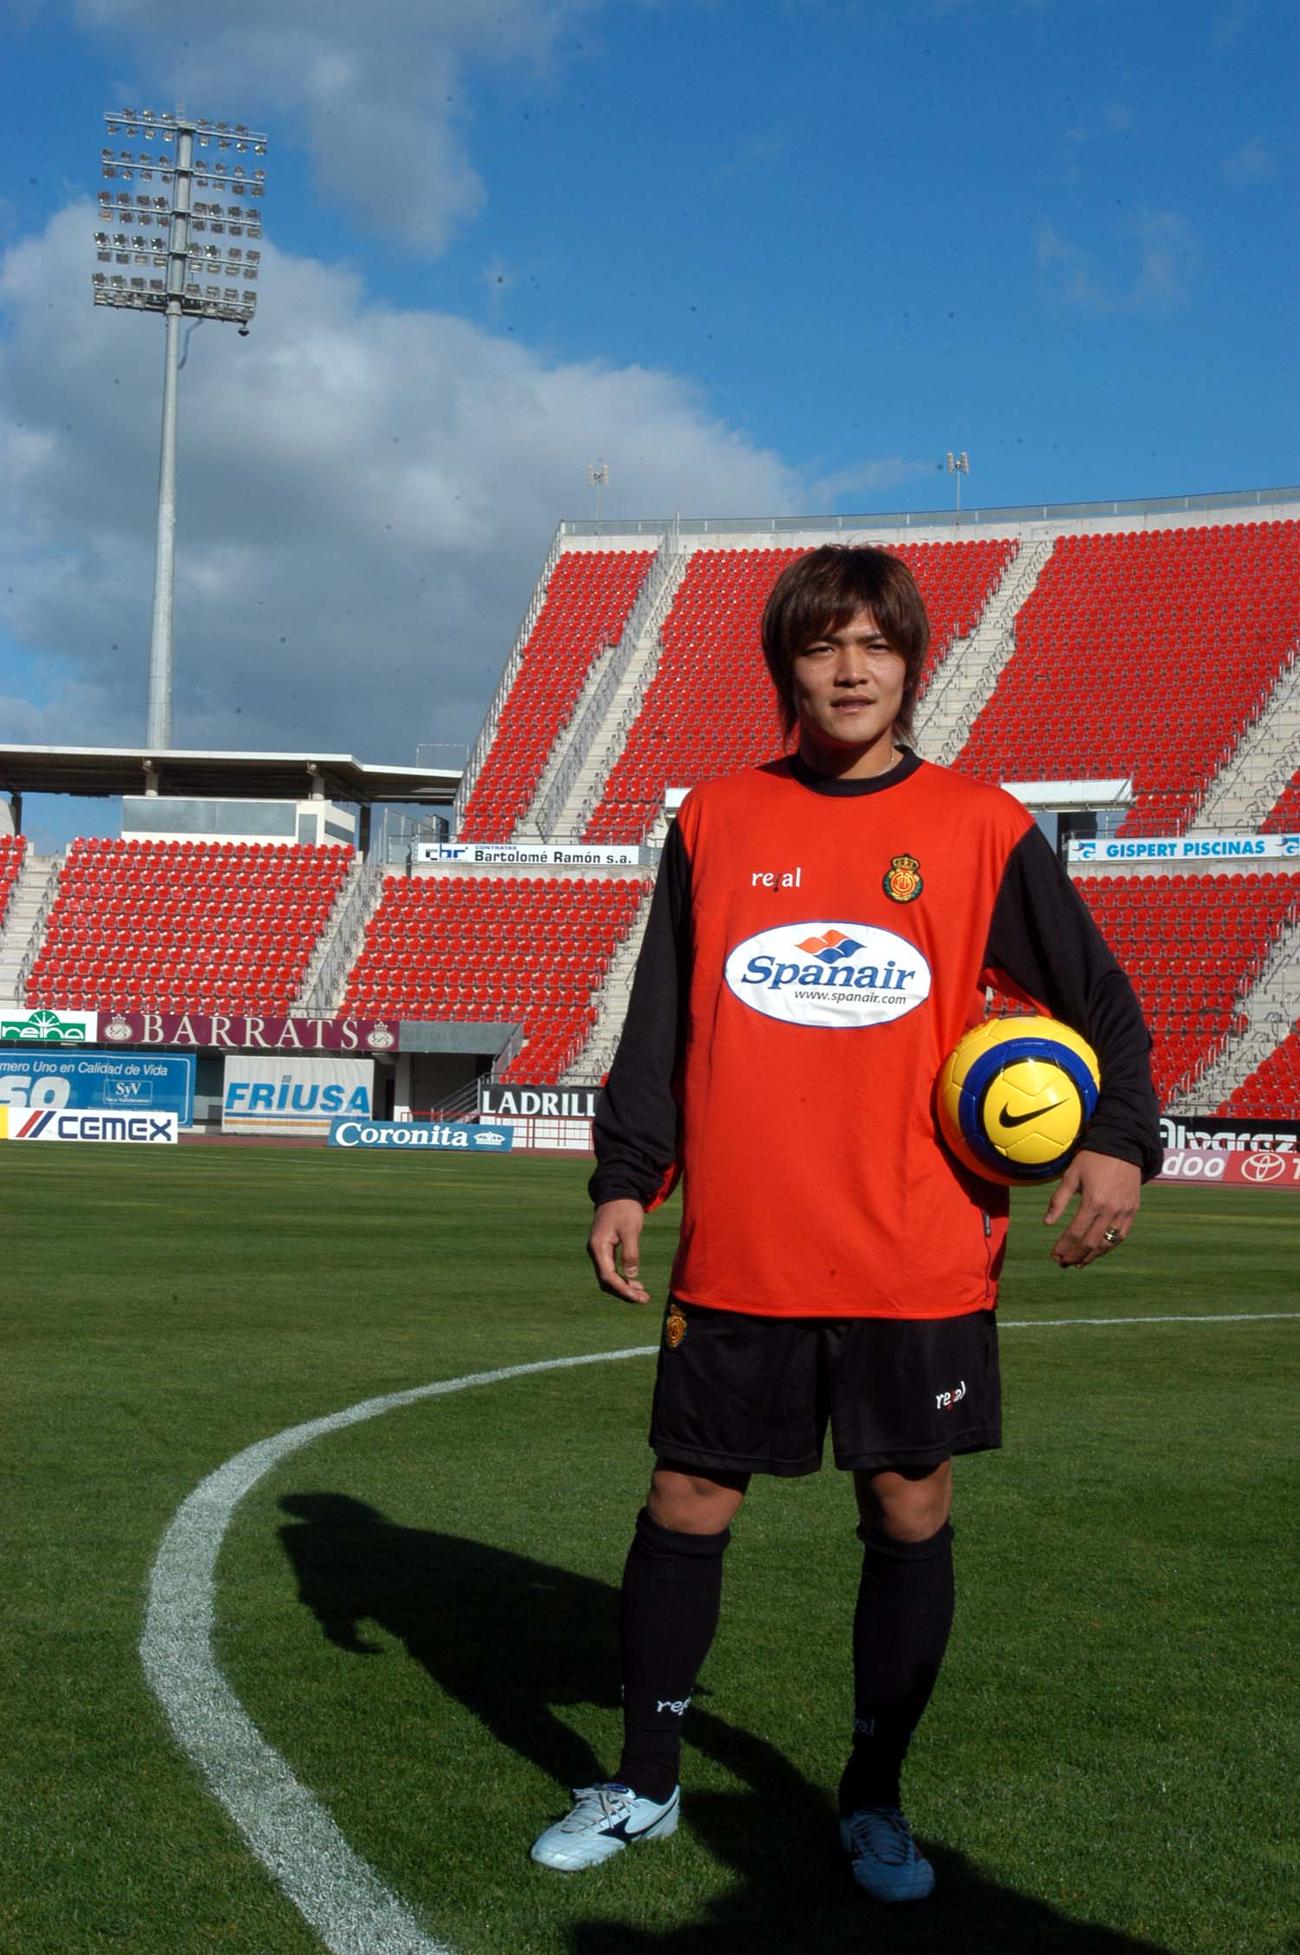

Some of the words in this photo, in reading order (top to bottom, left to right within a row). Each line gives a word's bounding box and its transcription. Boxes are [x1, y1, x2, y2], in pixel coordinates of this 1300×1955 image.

[475, 850, 548, 863] Bartolomé
[553, 850, 601, 864] Ramón
[606, 854, 632, 864] s.a.
[1106, 843, 1177, 858] GISPERT
[1184, 841, 1265, 856] PISCINAS
[741, 955, 916, 991] Spanair
[794, 989, 907, 1005] www.spanair.com
[1, 1024, 86, 1040] reina
[142, 1014, 358, 1050] BARRATS
[33, 1061, 58, 1073] Uno
[60, 1063, 75, 1073] en
[78, 1062, 122, 1075] Calidad
[124, 1064, 140, 1076] de
[143, 1065, 168, 1077] Vida
[115, 1082, 141, 1097] SyV
[58, 1116, 172, 1142] CEMEX
[335, 1122, 469, 1148] Coronita
